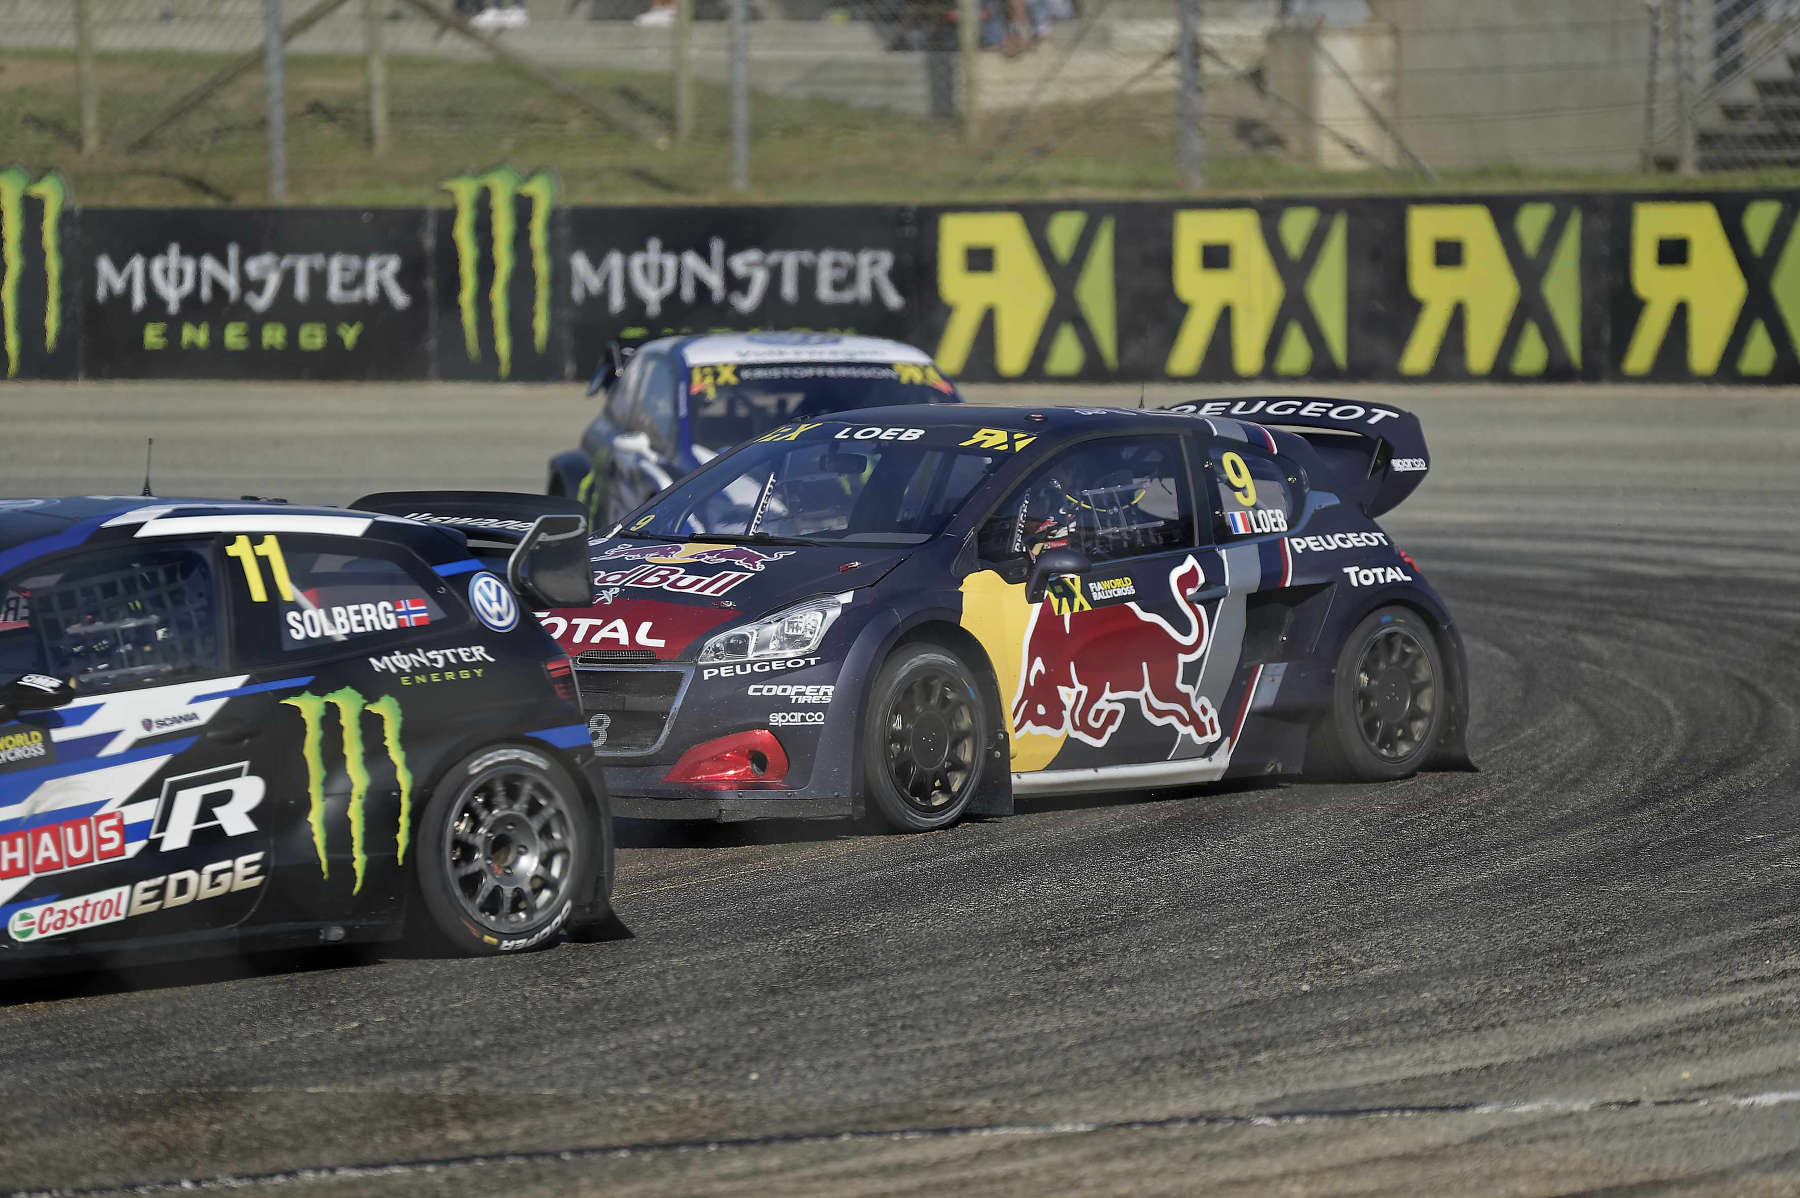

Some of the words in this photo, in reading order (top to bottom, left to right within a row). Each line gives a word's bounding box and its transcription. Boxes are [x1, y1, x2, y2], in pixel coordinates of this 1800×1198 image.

[95, 242, 412, 314] MONSTER
[569, 236, 905, 317] MONSTER
[143, 321, 365, 351] ENERGY
[834, 427, 926, 441] LOEB
[1221, 451, 1257, 507] 9
[1250, 508, 1288, 534] LOEB
[1290, 532, 1389, 554] PEUGEOT
[225, 534, 296, 602] 11
[1343, 565, 1412, 588] TOTAL
[286, 600, 399, 640] SOLBERG
[368, 645, 496, 675] MONSTER
[703, 657, 821, 680] PEUGEOT
[400, 668, 485, 686] ENERGY
[748, 684, 835, 696] COOPER
[790, 695, 832, 704] TIRES
[155, 712, 200, 730] SCANIA
[769, 711, 825, 727] sparco
[160, 775, 266, 852] R
[128, 851, 266, 918] EDGE
[38, 891, 124, 935] Castrol
